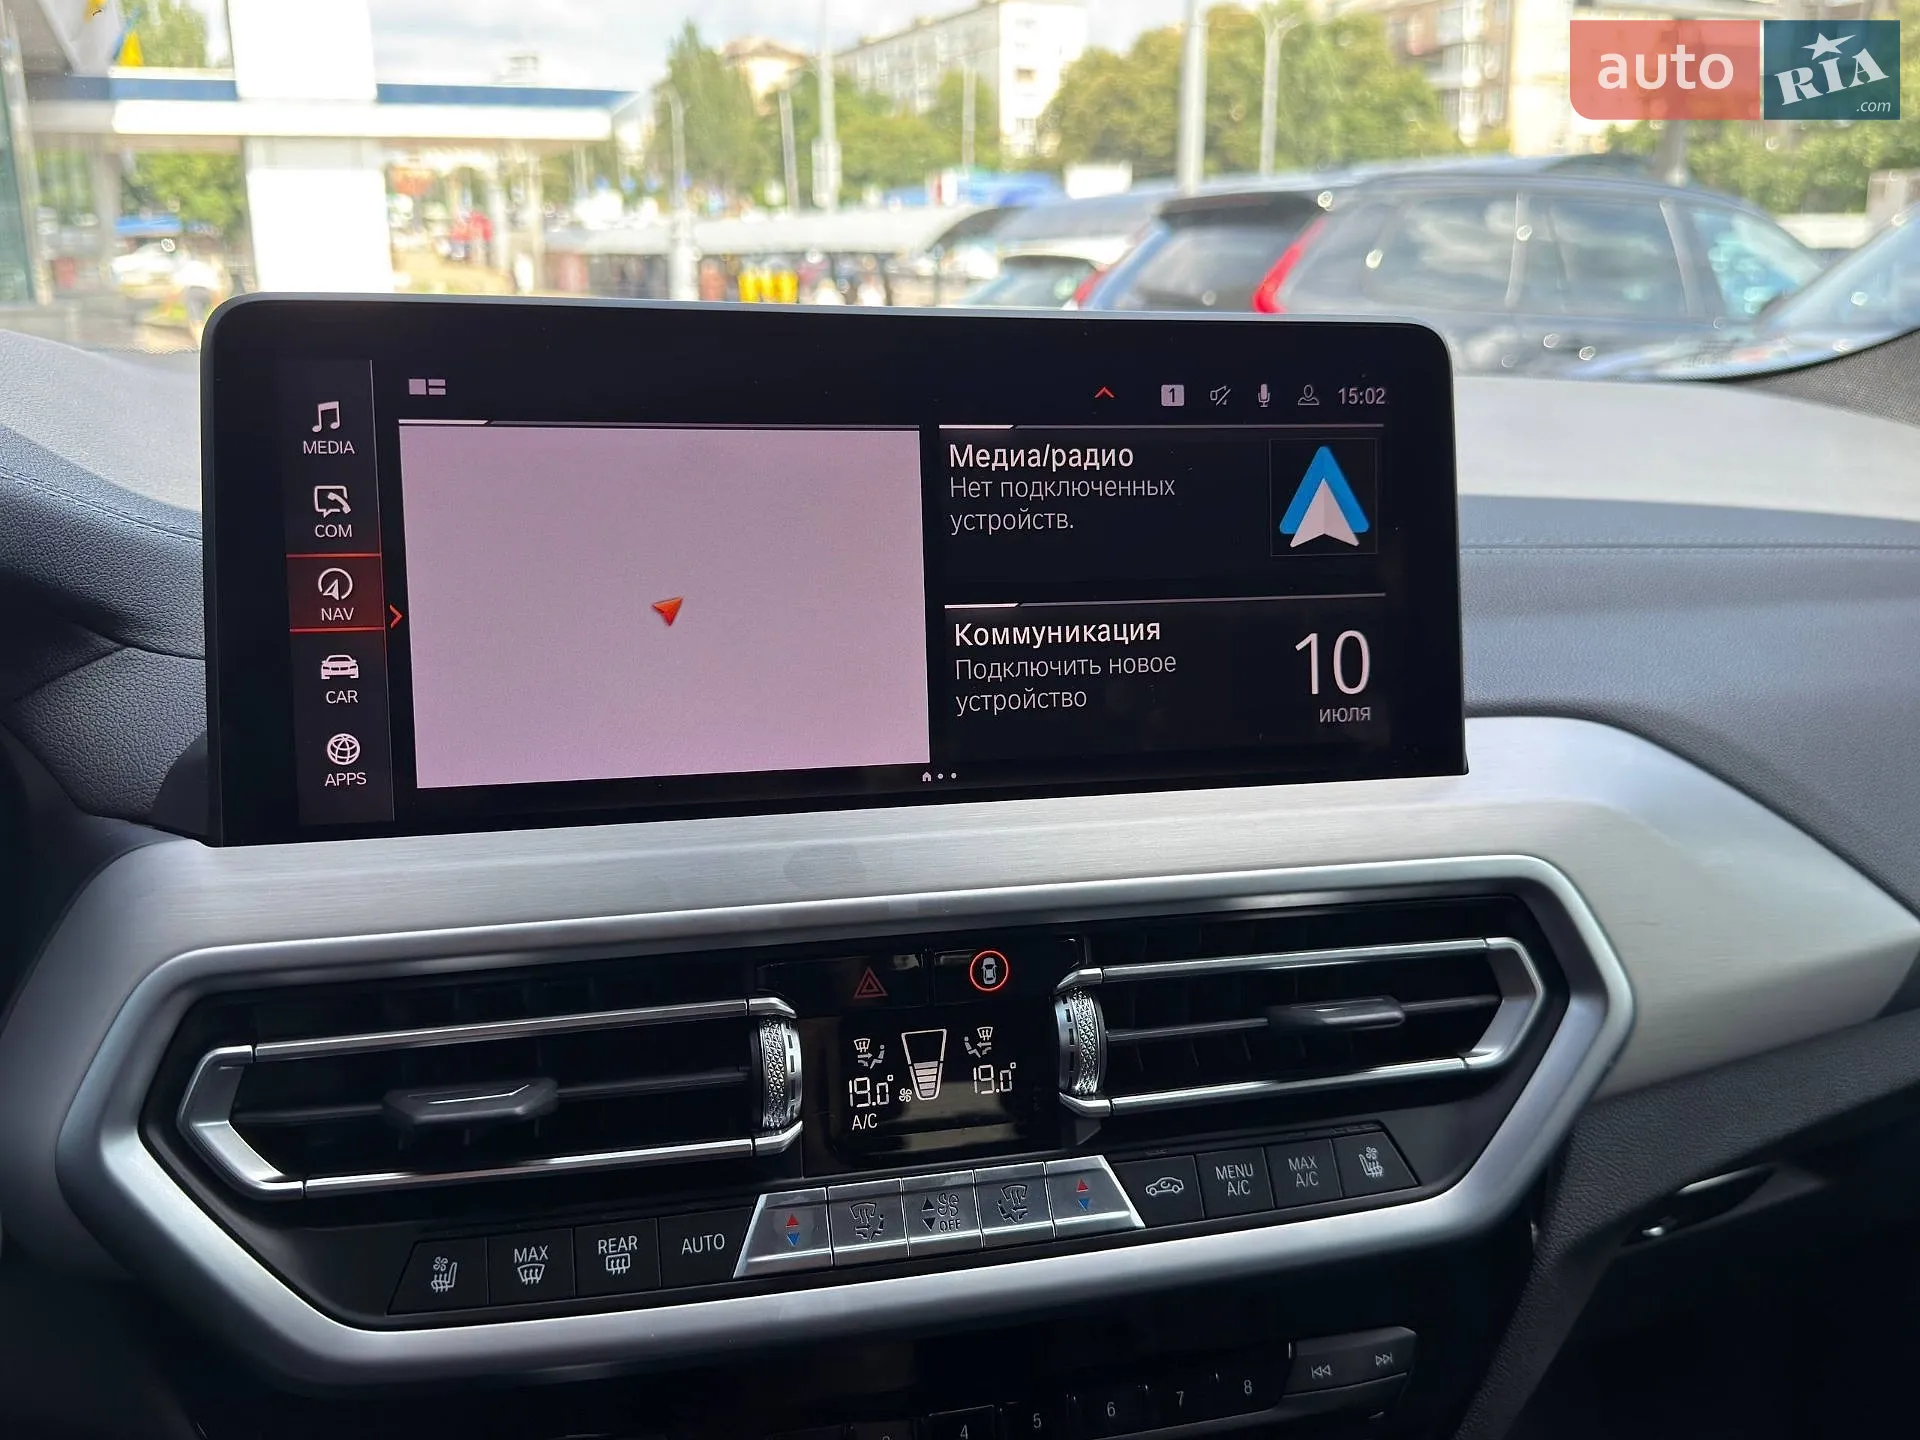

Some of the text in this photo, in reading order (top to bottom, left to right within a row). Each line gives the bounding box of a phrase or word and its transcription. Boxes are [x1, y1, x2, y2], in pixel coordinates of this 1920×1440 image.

[1338, 387, 1386, 405] 15:02
[303, 441, 355, 455] MEDIA
[949, 444, 1134, 471] Медиа/радио
[950, 474, 1176, 501] Нет подключенных
[950, 508, 1074, 535] устройств.
[314, 524, 353, 538] COM
[321, 607, 354, 621] NAV
[955, 621, 1161, 649] Коммуникация
[955, 654, 1177, 683] Подключить новое
[1295, 630, 1371, 695] 10
[325, 690, 358, 704] CAR
[955, 687, 1088, 716] устройство
[1319, 705, 1371, 723] июля
[325, 772, 367, 787] APPS
[852, 1113, 878, 1130] A/C
[1216, 1163, 1253, 1181] MENU
[1288, 1156, 1318, 1171] MAX
[1227, 1179, 1250, 1196] A/C
[1295, 1171, 1319, 1188] A/C
[939, 1218, 961, 1232] OFF
[598, 1235, 638, 1255] REAR
[681, 1233, 725, 1254] AUTO
[513, 1245, 549, 1263] MAX
[1243, 1379, 1253, 1395] 8
[1176, 1390, 1184, 1407] 7
[1106, 1401, 1116, 1417] 6
[1033, 1412, 1042, 1429] 5
[960, 1423, 969, 1440] 4
